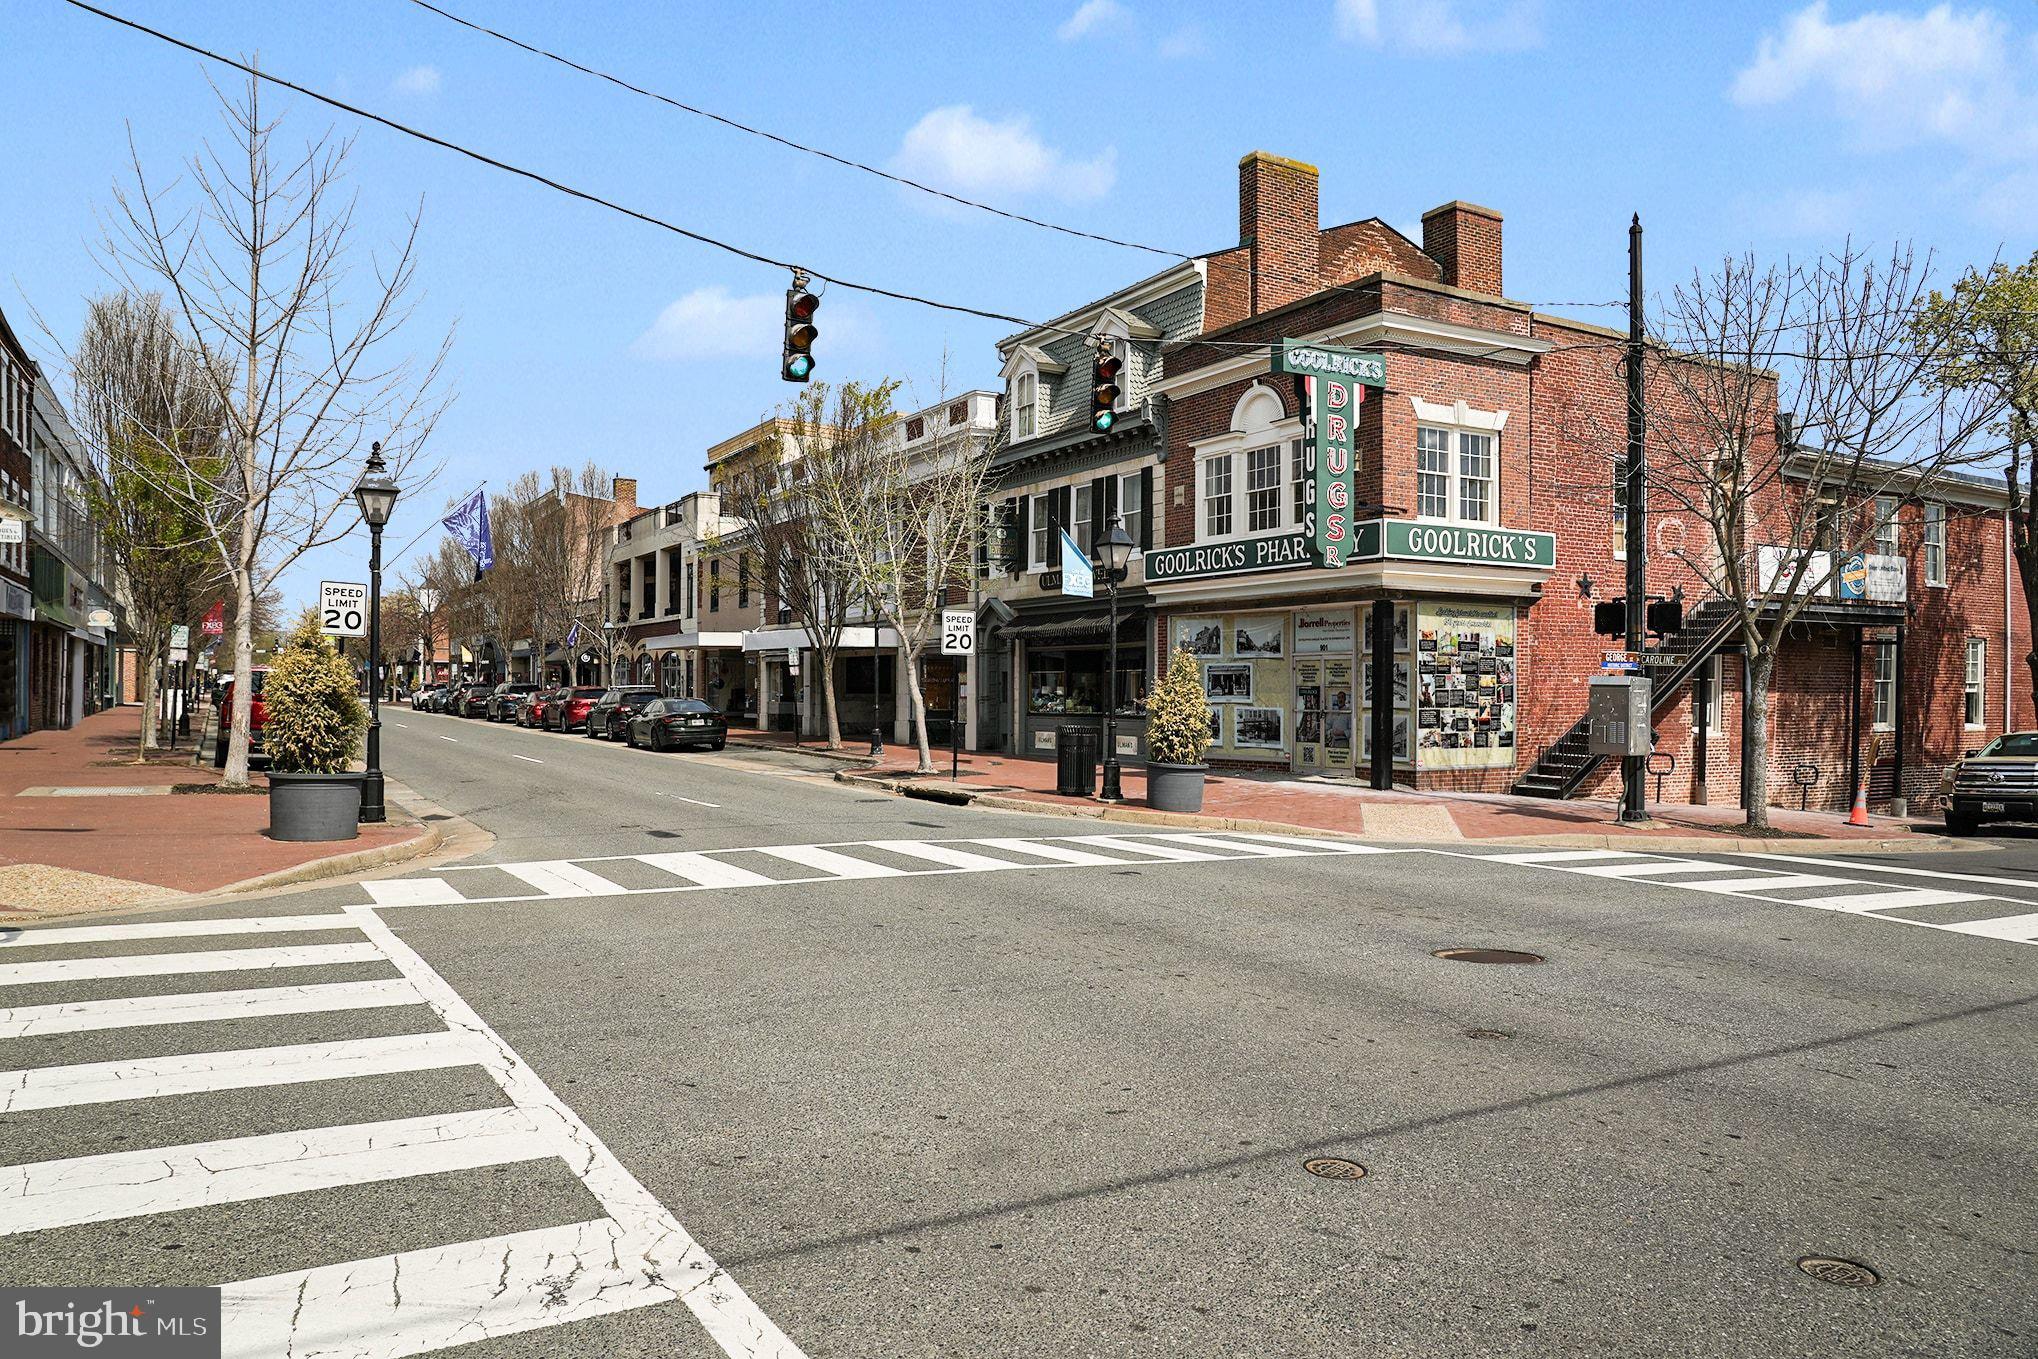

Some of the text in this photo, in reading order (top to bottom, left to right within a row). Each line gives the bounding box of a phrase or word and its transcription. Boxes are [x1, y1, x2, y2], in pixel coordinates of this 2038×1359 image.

[1305, 392, 1316, 538] RUGS
[1326, 380, 1349, 542] DRUGS
[1154, 528, 1364, 576] GOOLRICK'S PHARY
[1408, 527, 1537, 561] GOOLRICK'S
[325, 587, 363, 598] SPEED
[328, 599, 359, 608] LIMIT
[323, 609, 362, 630] 20
[945, 615, 973, 624] SPEED
[945, 633, 972, 650] 20
[1605, 652, 1628, 662] GEORGE
[1641, 655, 1675, 665] CAROLINE
